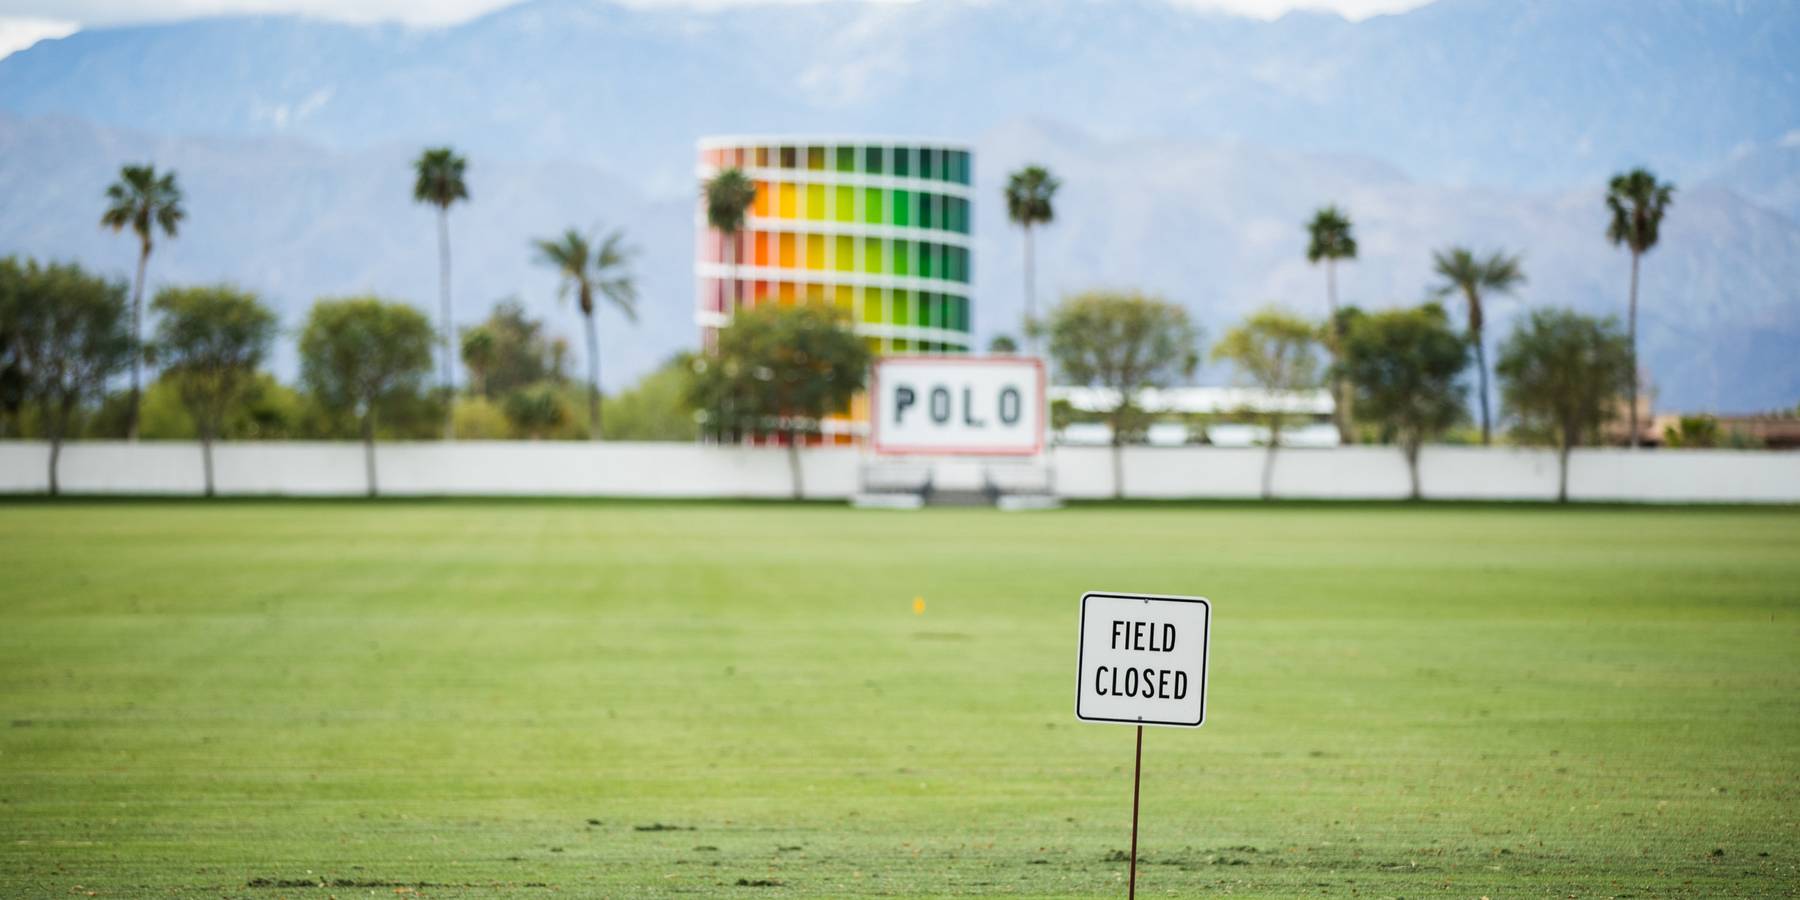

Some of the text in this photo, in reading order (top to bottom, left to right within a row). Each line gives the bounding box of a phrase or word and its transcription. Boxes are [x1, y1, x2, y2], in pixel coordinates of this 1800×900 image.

[894, 385, 1022, 426] POLO
[1111, 620, 1176, 652] FIELD
[1095, 665, 1188, 700] CLOSED
